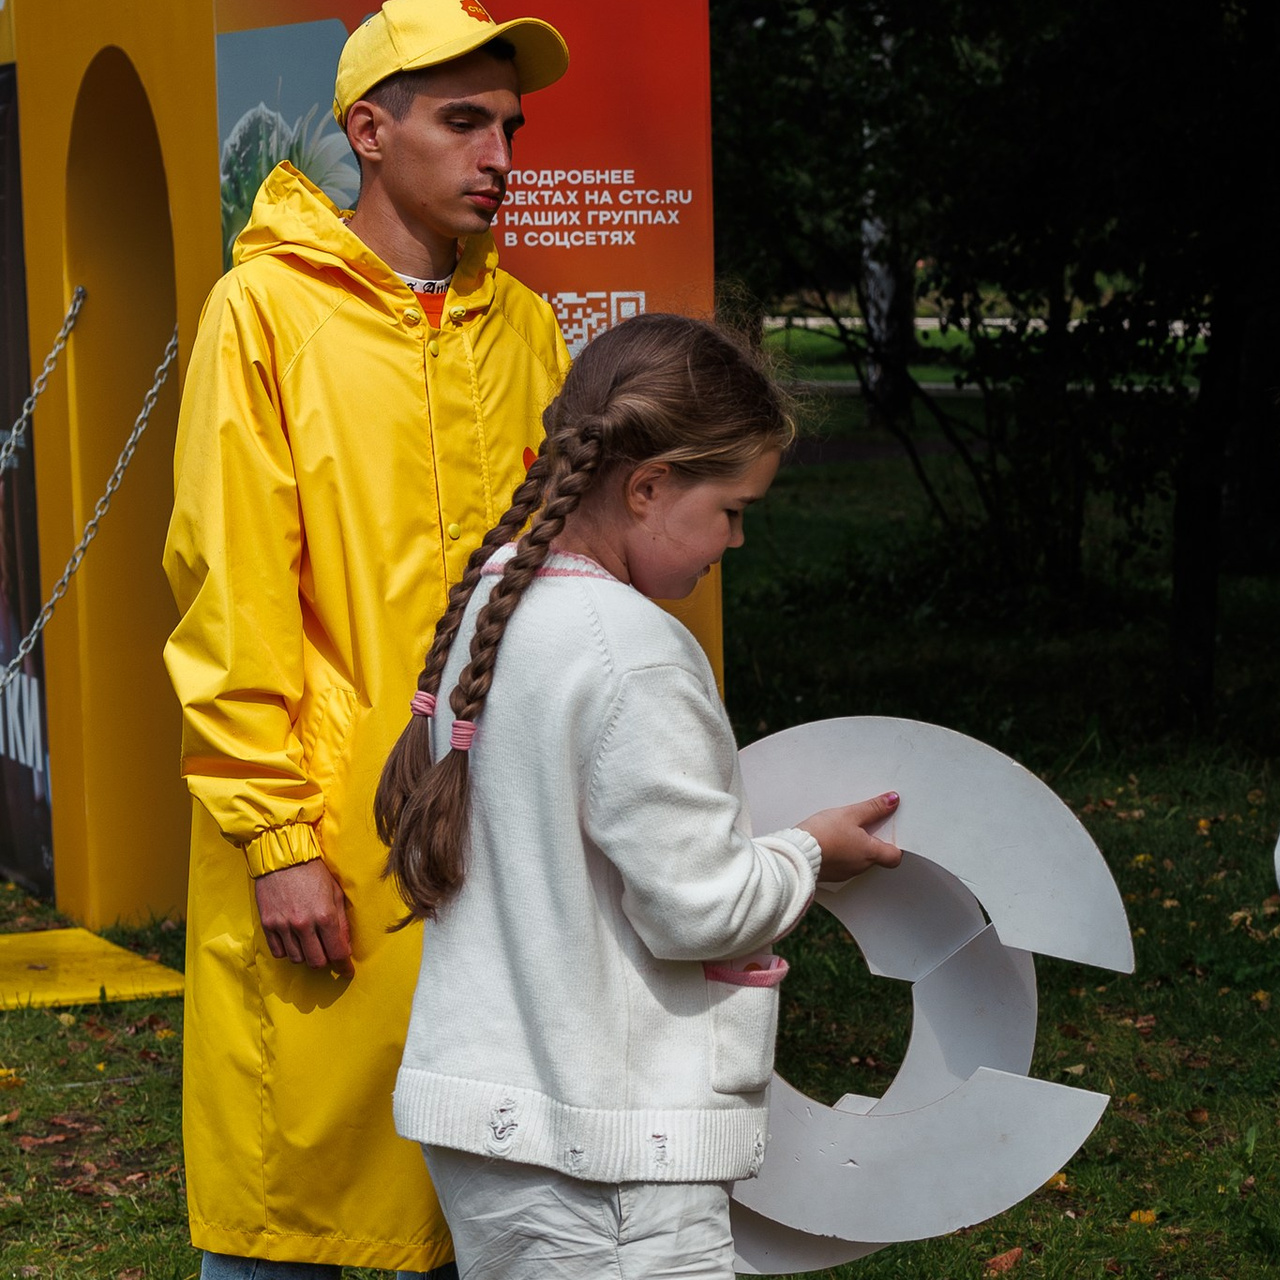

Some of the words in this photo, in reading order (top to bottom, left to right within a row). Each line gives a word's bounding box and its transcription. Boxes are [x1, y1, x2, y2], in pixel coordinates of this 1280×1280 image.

[507, 169, 636, 188] ПОДРОБНЕЕ
[502, 190, 579, 206] ОЕКТАХ
[585, 190, 614, 205] НА
[618, 189, 693, 205] CTC.RU
[505, 211, 581, 226] НАШИХ
[587, 210, 680, 225] ГРУППАХ
[504, 232, 519, 247] В
[523, 231, 636, 249] СОЦСЕТЯХ
